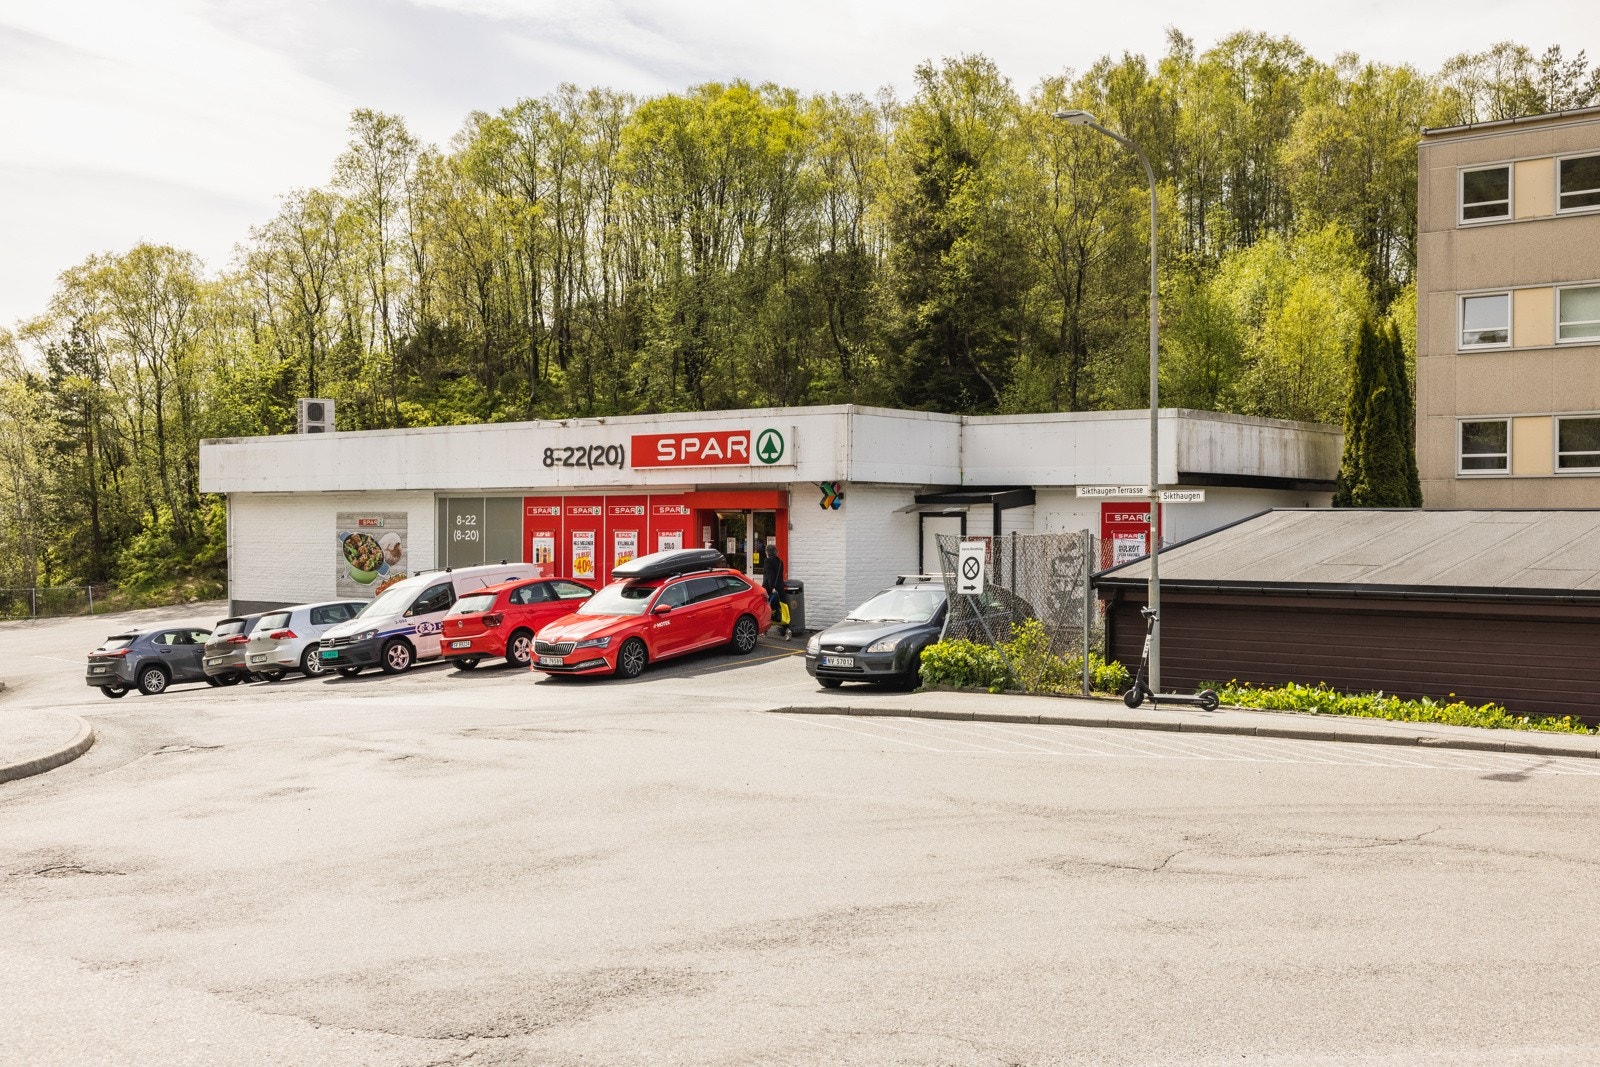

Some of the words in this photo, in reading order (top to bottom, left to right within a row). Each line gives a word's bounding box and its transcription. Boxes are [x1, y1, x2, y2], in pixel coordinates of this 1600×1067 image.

[656, 435, 748, 461] SPAR
[542, 443, 625, 471] 8-22(20)
[1081, 487, 1116, 496] Sikthaugen
[1163, 492, 1201, 501] Sikthaugen
[456, 515, 477, 525] 8-22
[453, 530, 480, 542] (8-20)
[574, 559, 594, 573] -40%
